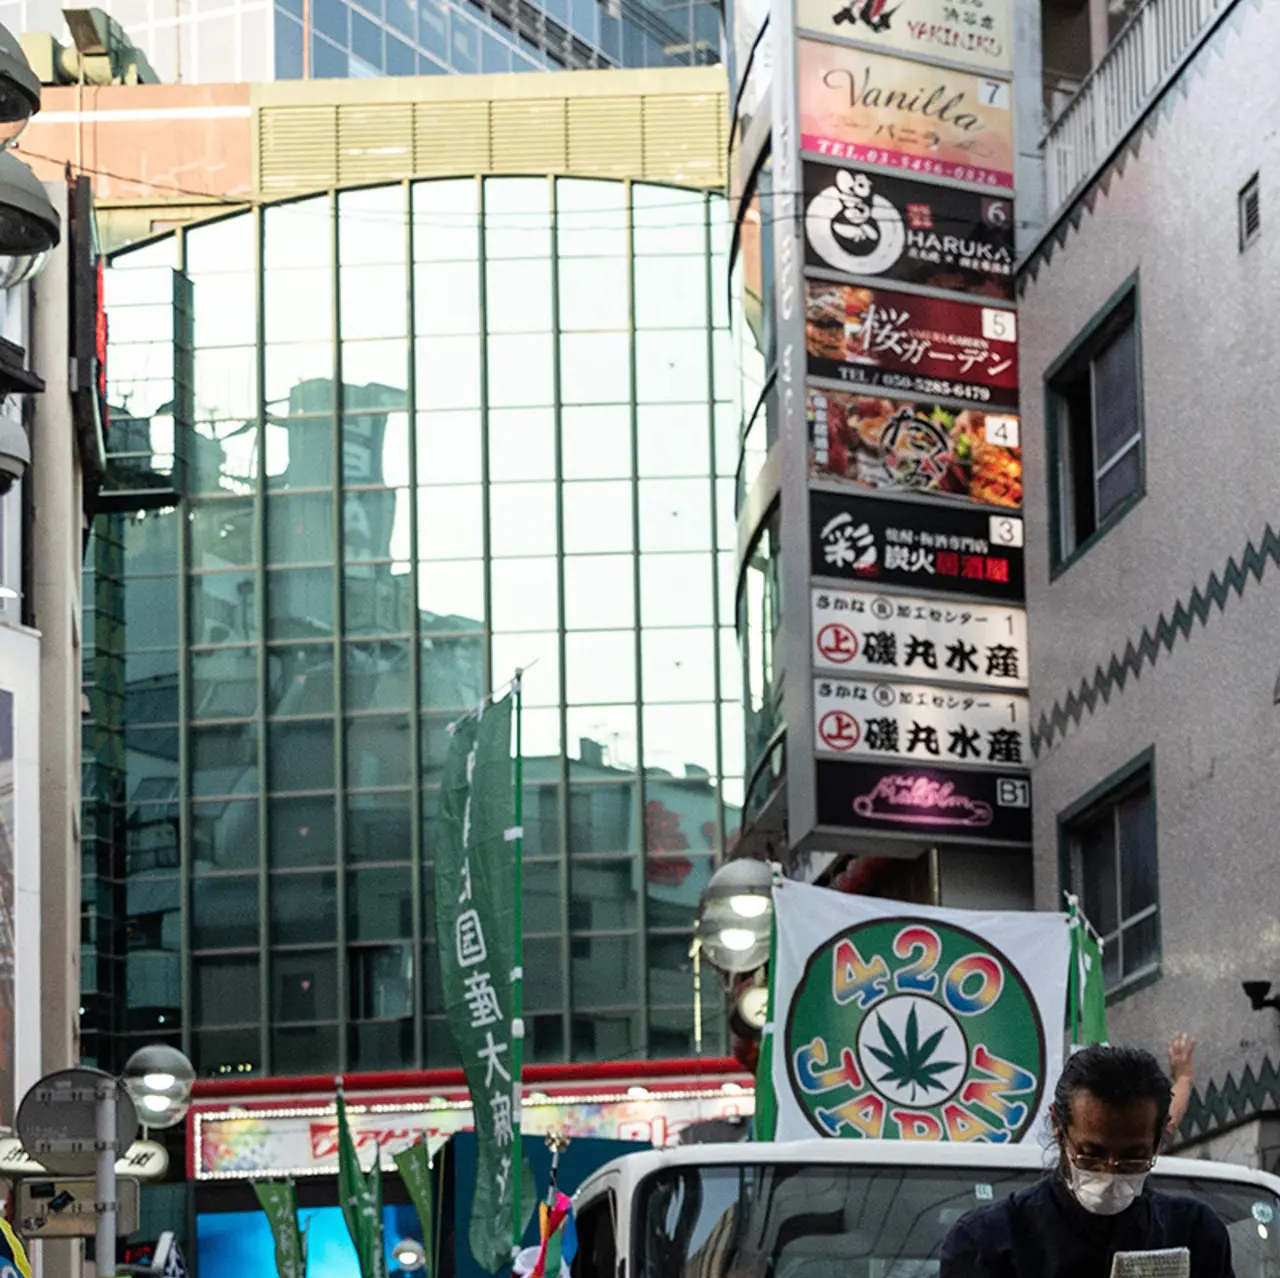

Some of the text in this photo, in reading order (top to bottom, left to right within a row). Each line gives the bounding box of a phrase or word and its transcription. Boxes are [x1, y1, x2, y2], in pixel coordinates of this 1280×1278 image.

[823, 66, 982, 132] Vanilla
[985, 82, 1001, 104] 7
[987, 202, 1006, 225] 6
[906, 229, 1012, 264] HARUKA
[859, 302, 1013, 377] 桜ガーデン
[991, 313, 1006, 338] 5
[993, 422, 1009, 442] 4
[820, 511, 878, 568] 彩
[998, 520, 1015, 544] 3
[815, 595, 866, 614] さかな
[896, 603, 989, 627] 加工センター
[1005, 613, 1015, 637] 1
[821, 626, 1020, 680] 上 磯丸水産
[817, 682, 868, 700] さかな
[898, 691, 991, 711] 加工センター
[1007, 702, 1017, 724] 1
[823, 713, 1023, 765] 上 磯丸水産
[1000, 780, 1030, 806] B1
[832, 924, 1005, 1015] 420
[794, 1037, 1037, 1143] JAPAN
